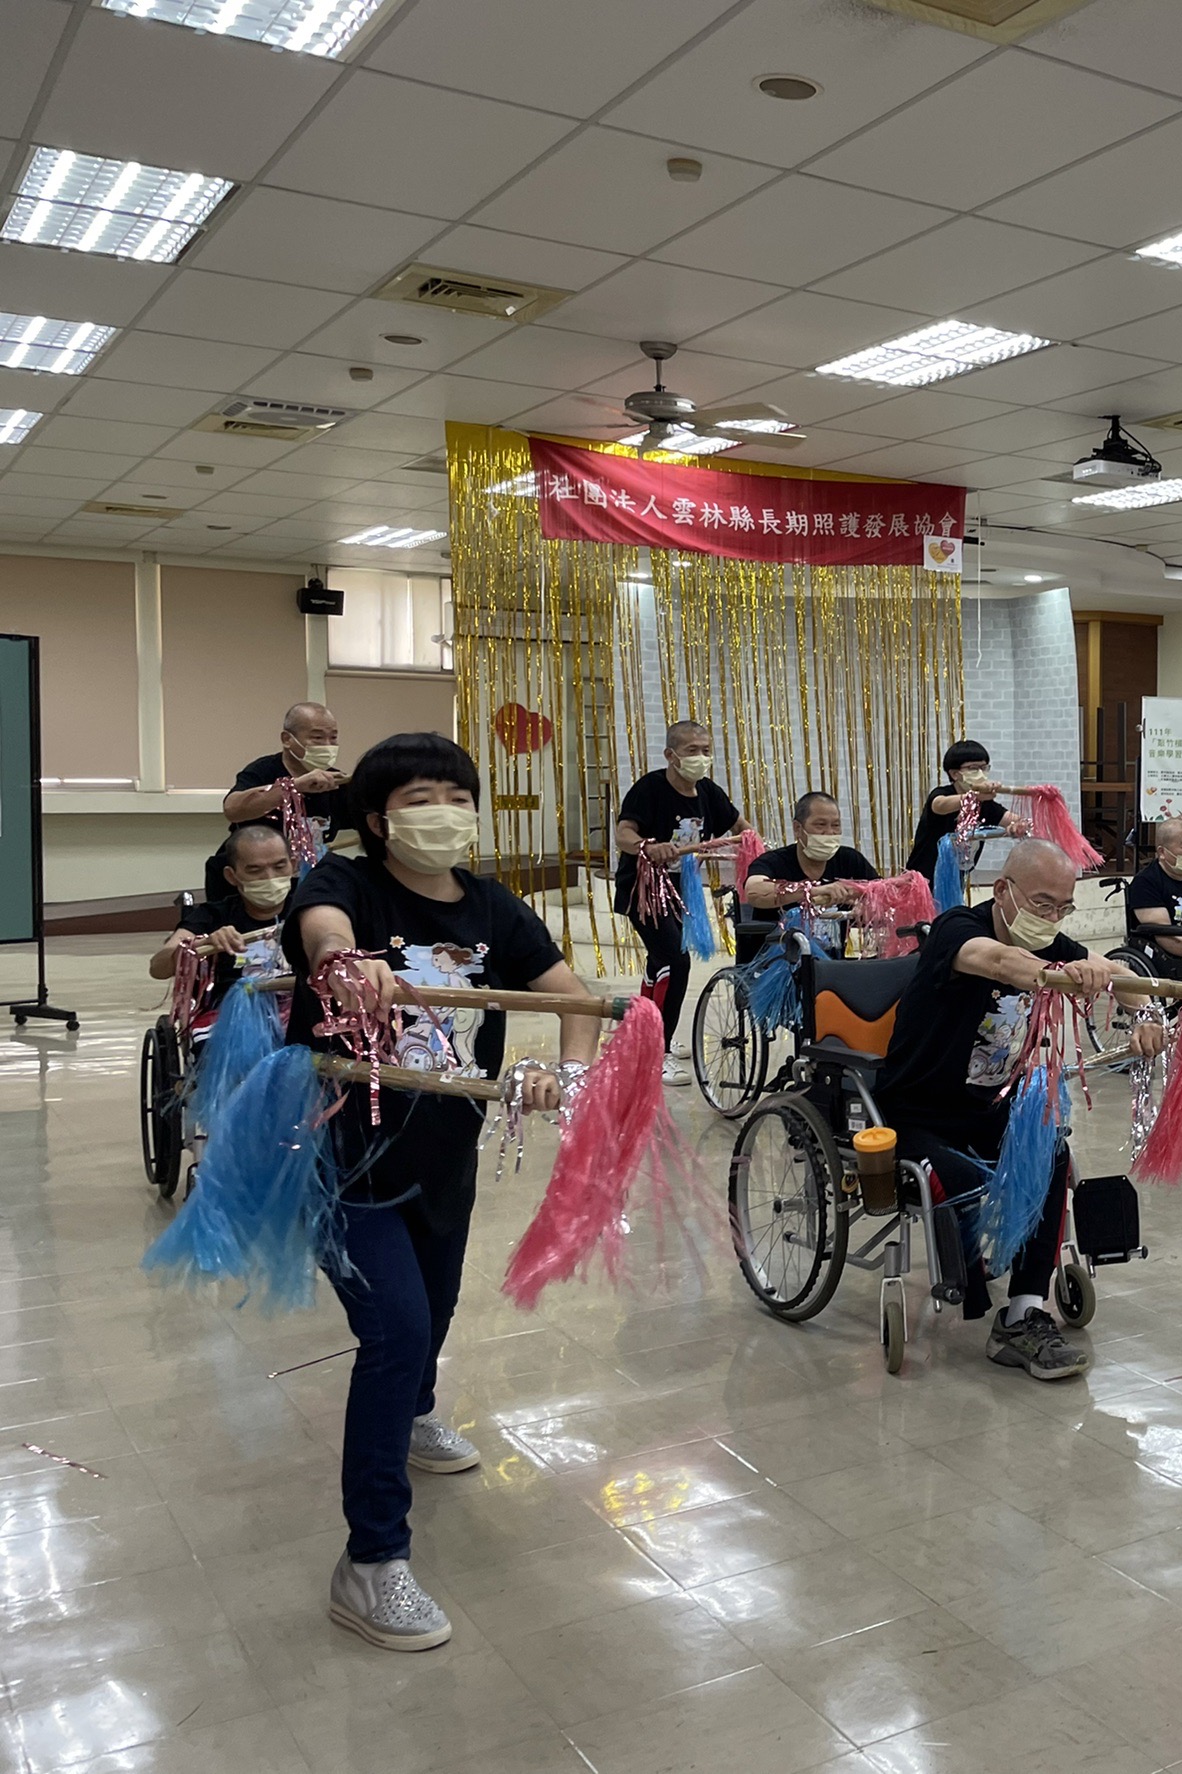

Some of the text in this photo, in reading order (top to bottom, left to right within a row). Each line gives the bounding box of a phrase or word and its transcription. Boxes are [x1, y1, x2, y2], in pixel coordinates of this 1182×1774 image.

[548, 474, 958, 538] 社團法人雲林縣長期照護發展協會
[1149, 728, 1172, 736] 111年
